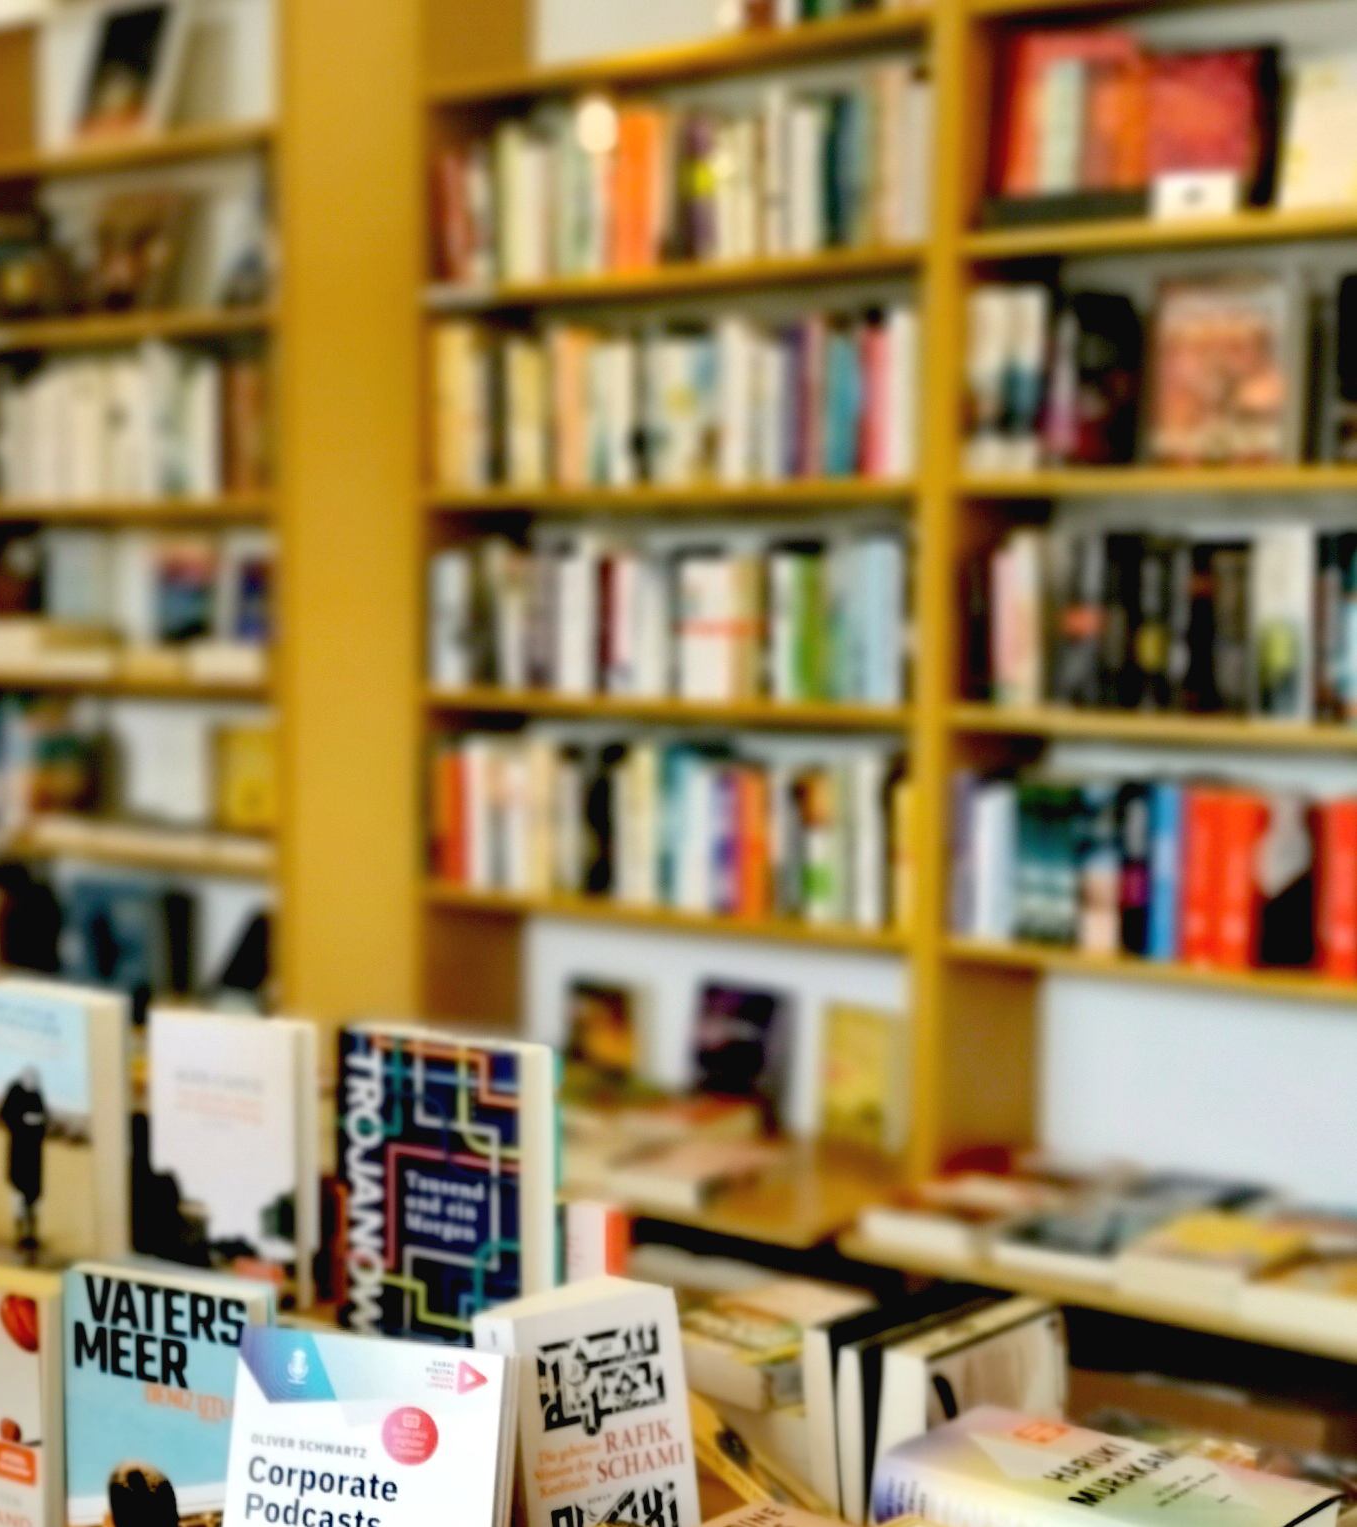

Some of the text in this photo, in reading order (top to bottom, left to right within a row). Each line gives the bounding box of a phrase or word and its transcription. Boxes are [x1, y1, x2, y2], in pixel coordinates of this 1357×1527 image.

[404, 1168, 485, 1202] Tausend
[404, 1194, 477, 1222] und ein
[404, 1210, 477, 1243] Morgen
[85, 1274, 246, 1347] VATERS
[74, 1320, 188, 1389] MEER
[251, 1433, 367, 1459] OLIVER SCHWARTZ
[605, 1419, 673, 1454] RAFIK
[248, 1455, 398, 1503] Corporate
[597, 1442, 685, 1484] SCHAMI
[1043, 1443, 1131, 1484] HARUKI
[1068, 1450, 1178, 1507] MURAKAM
